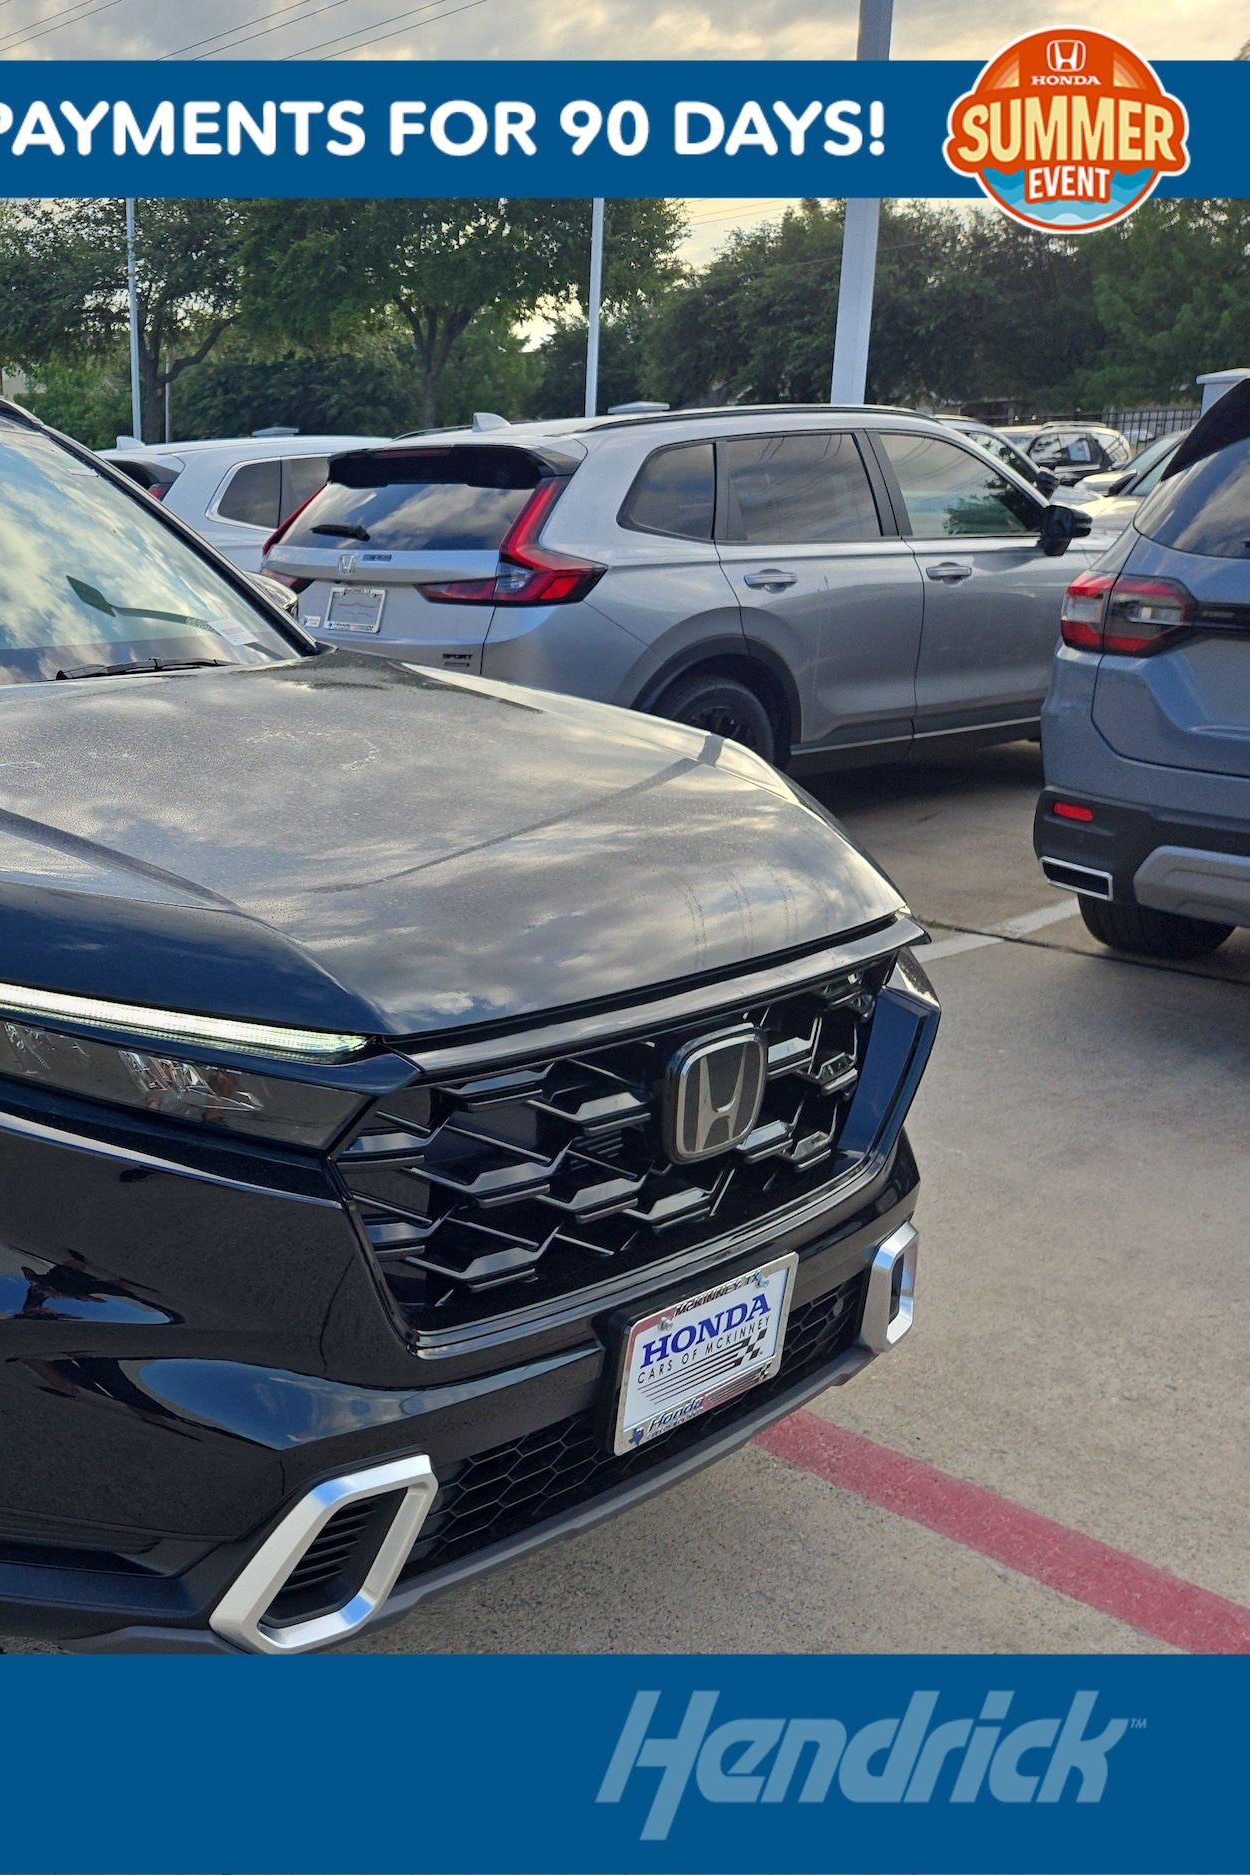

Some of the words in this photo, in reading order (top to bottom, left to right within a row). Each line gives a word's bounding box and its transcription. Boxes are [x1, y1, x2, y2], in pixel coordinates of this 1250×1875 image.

[637, 1359, 673, 1384] CARS
[682, 1347, 698, 1365] OF
[705, 1314, 771, 1355] MCKINNEY
[640, 1293, 771, 1369] HONDA
[648, 1395, 705, 1432] Honda
